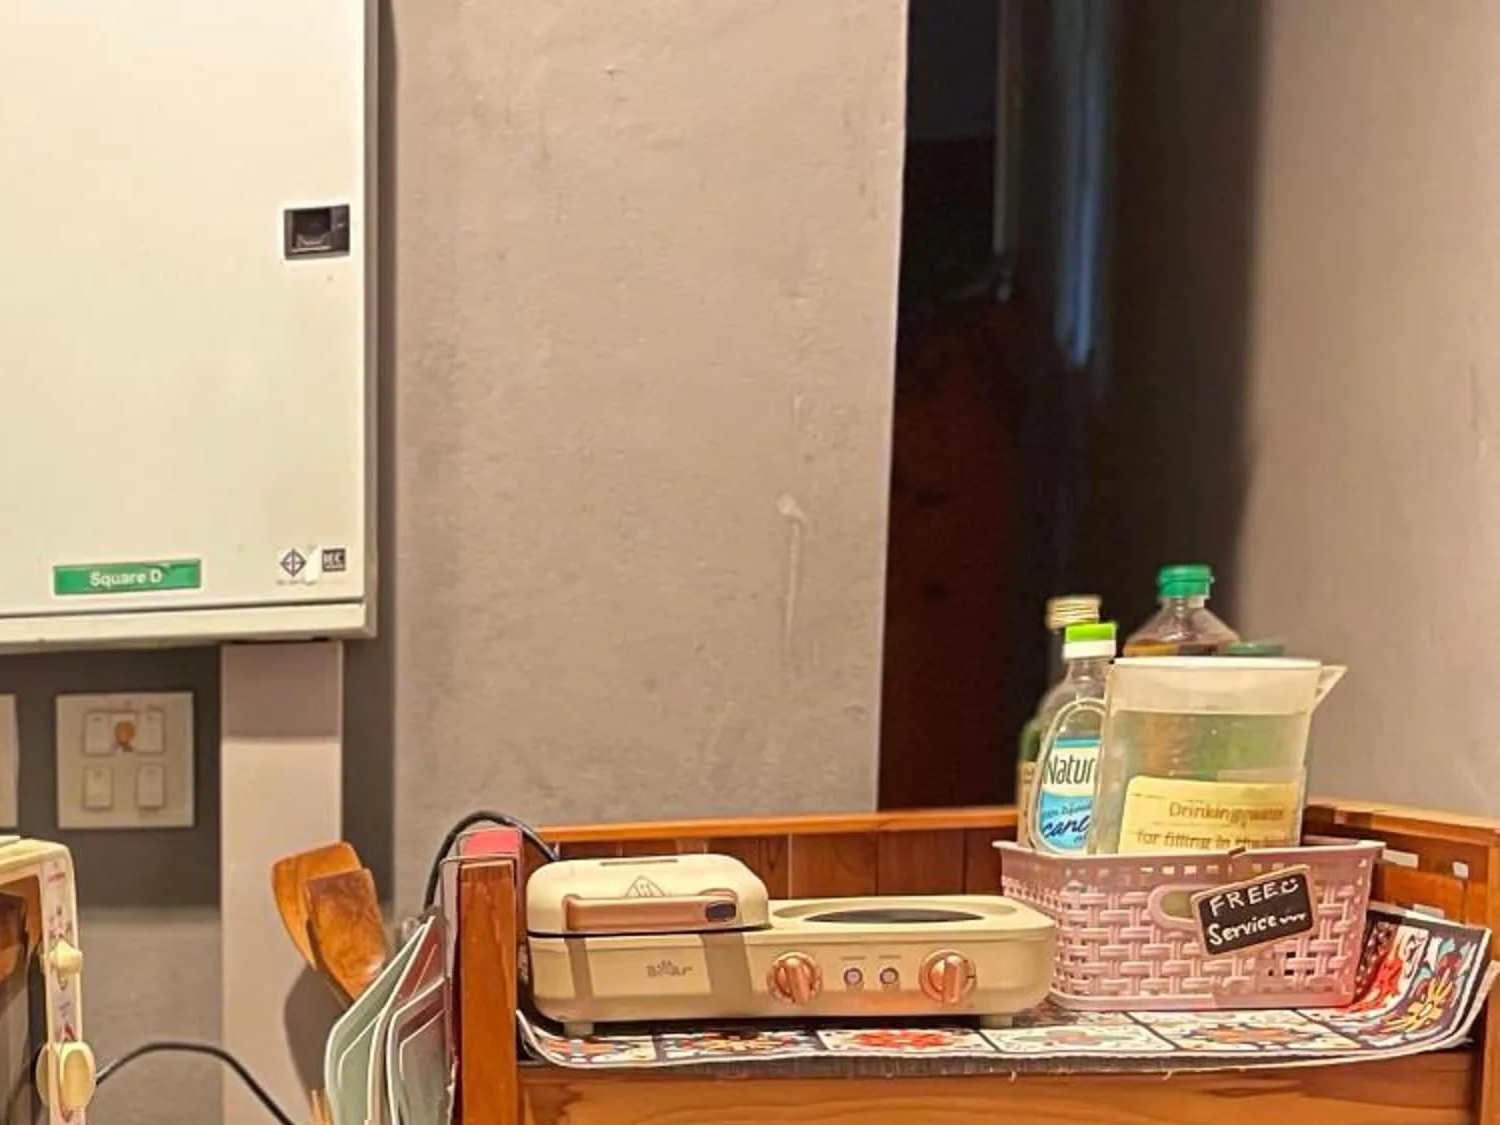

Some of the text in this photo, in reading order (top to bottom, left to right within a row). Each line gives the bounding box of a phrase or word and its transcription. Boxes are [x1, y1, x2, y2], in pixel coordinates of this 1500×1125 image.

[89, 567, 163, 587] Square D
[1043, 755, 1095, 785] Natur
[1209, 881, 1278, 917] FREE
[1207, 915, 1277, 945] Service
